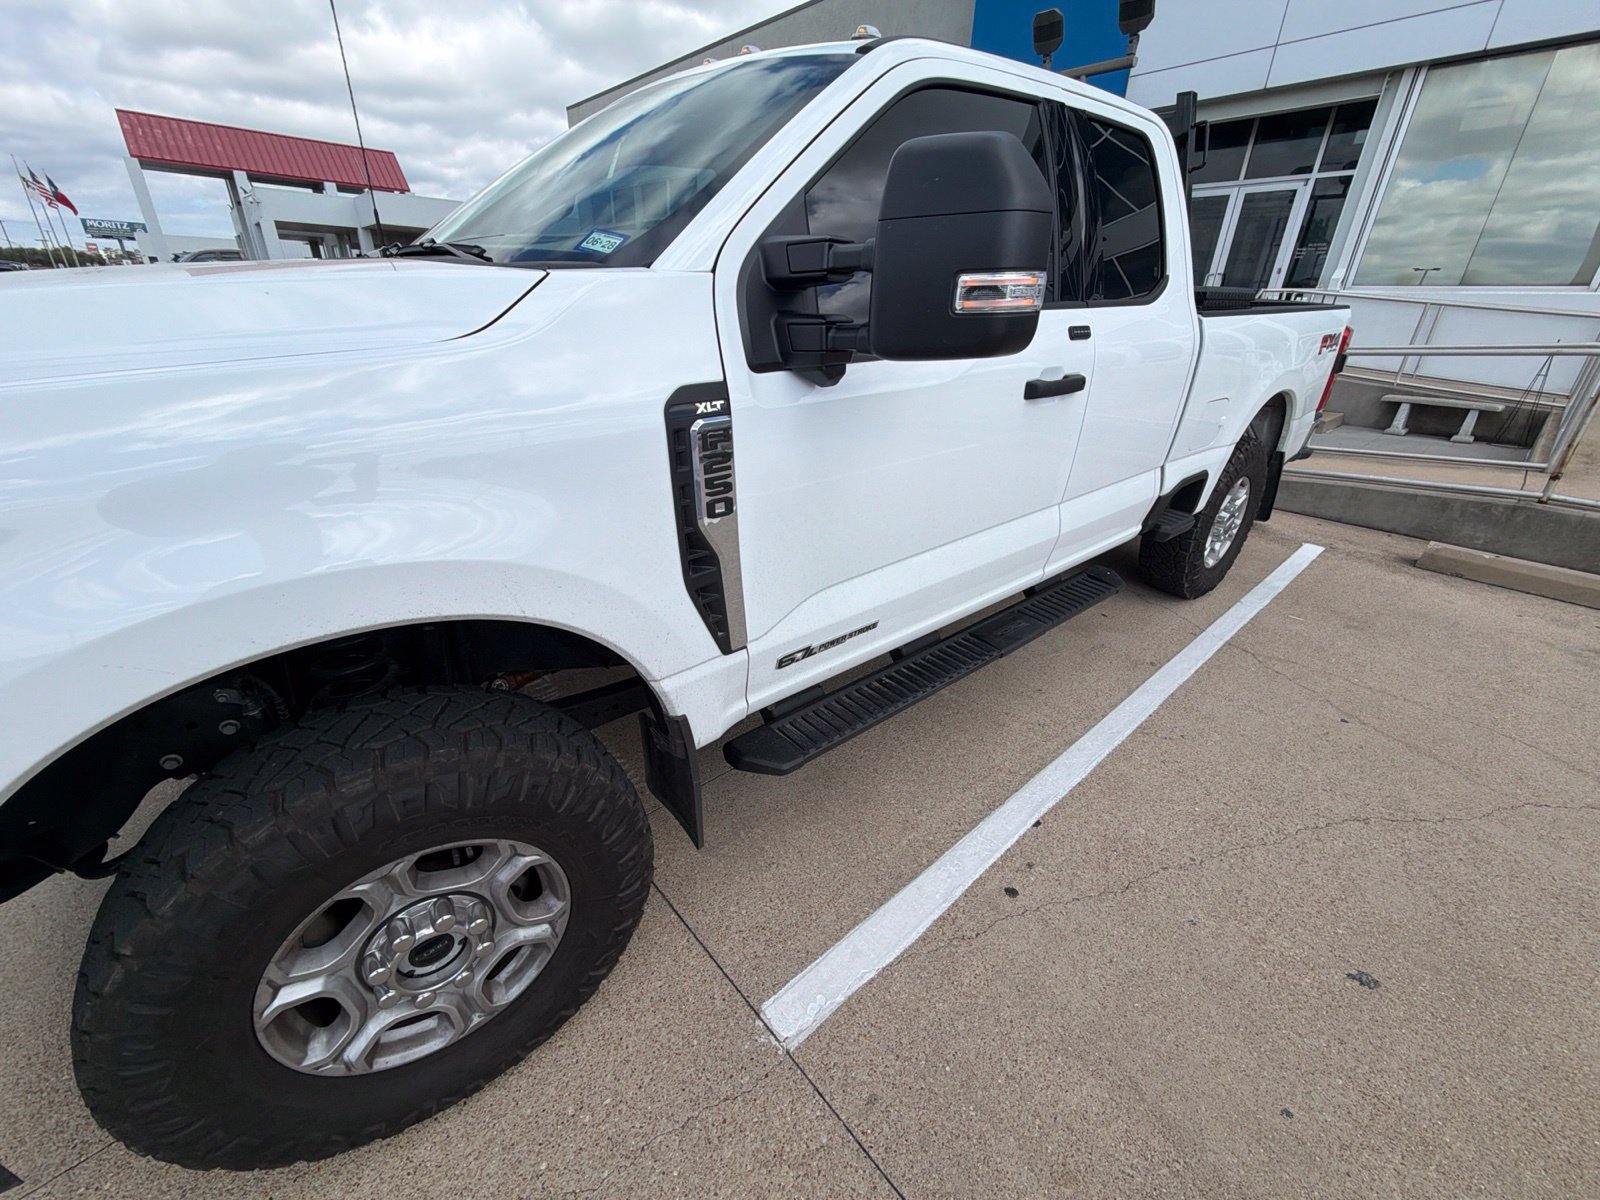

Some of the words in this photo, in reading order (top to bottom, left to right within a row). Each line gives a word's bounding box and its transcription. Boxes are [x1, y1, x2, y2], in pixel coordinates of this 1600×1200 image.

[86, 219, 130, 229] MORITZ
[695, 400, 724, 414] XLT
[818, 636, 847, 653] POWER
[847, 620, 879, 640] STROKE
